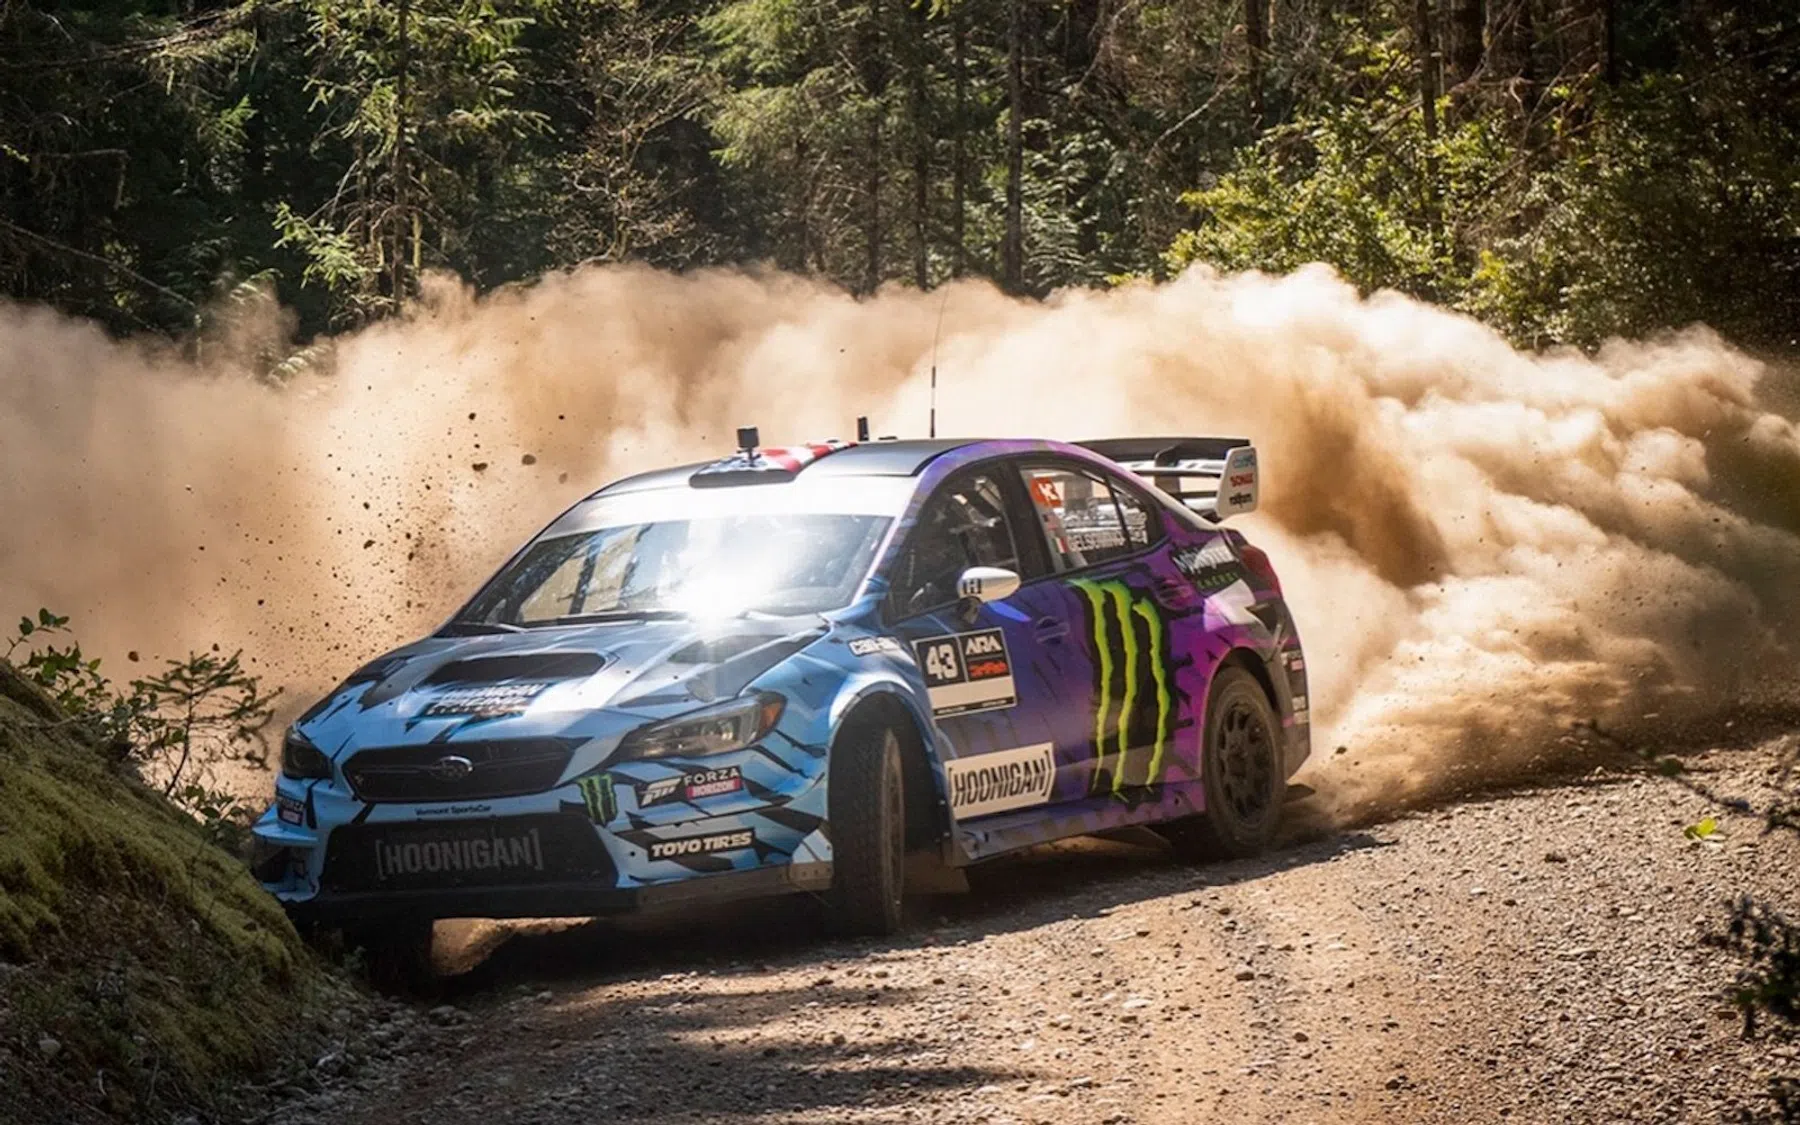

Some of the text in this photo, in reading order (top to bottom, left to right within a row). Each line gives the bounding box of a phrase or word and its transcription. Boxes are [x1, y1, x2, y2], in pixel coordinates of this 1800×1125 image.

[965, 635, 1002, 654] ARA
[925, 643, 958, 680] 43
[683, 767, 741, 786] FORZA
[651, 831, 753, 857] TOYO TIRES
